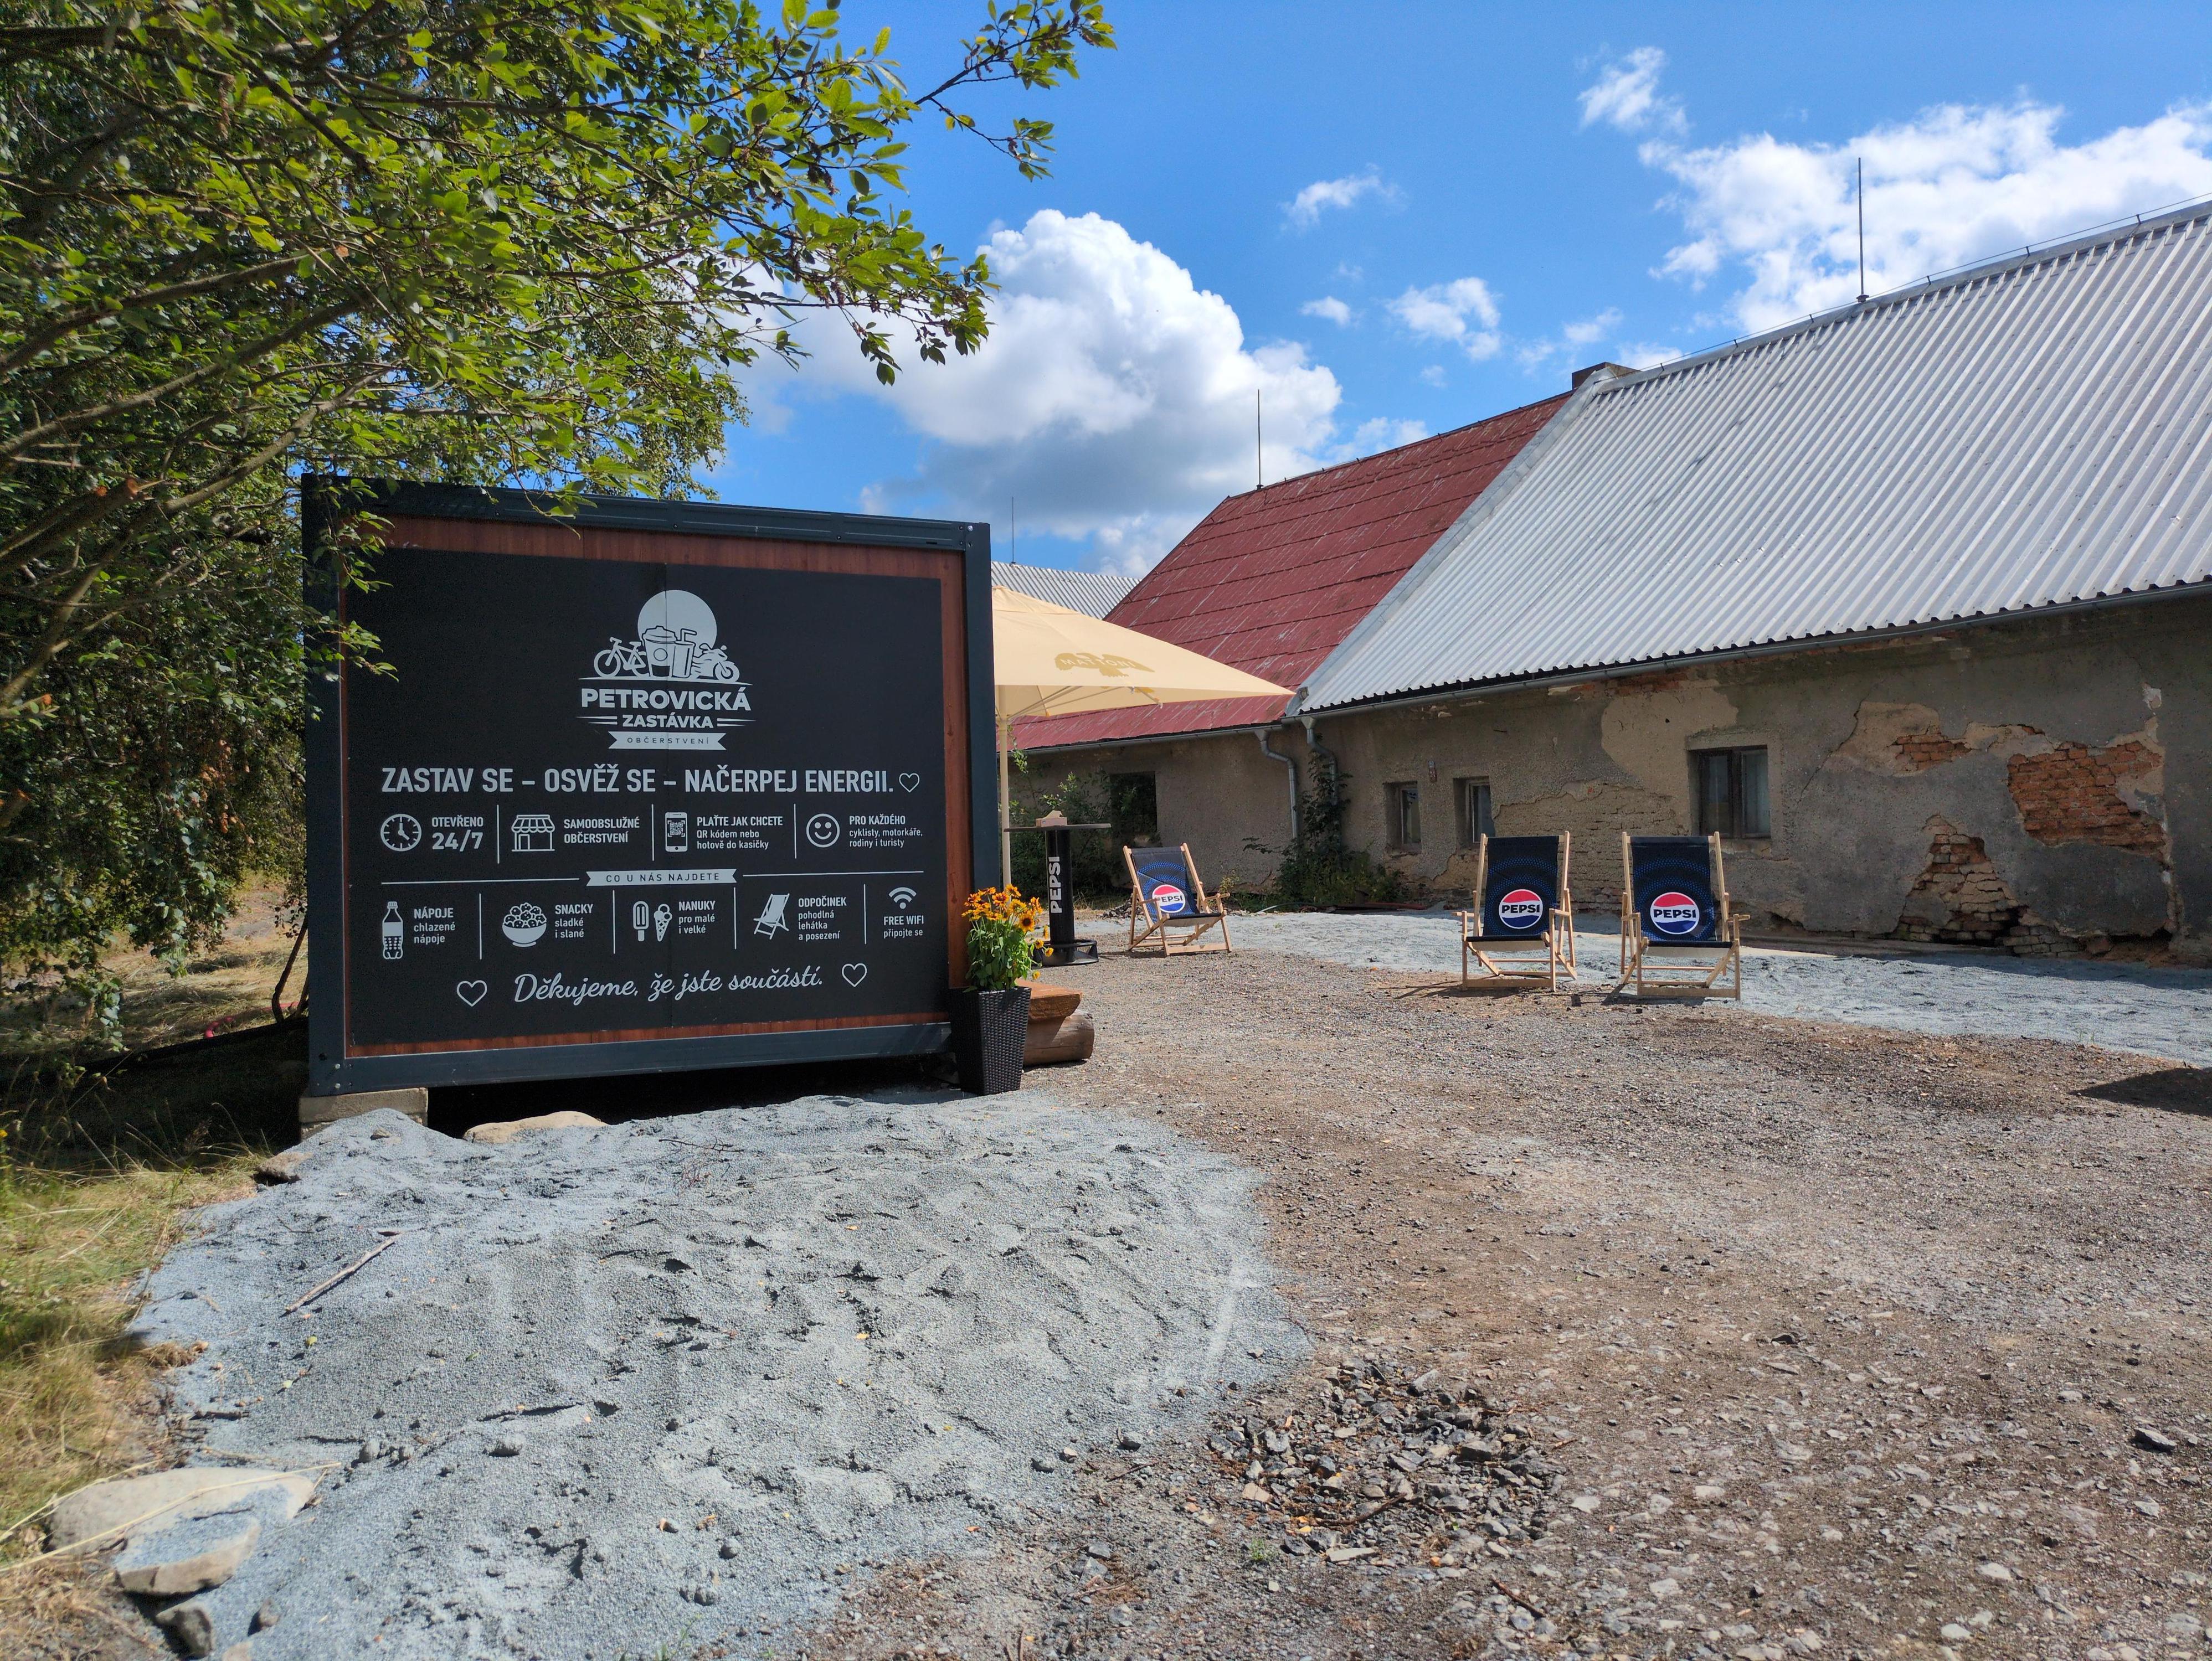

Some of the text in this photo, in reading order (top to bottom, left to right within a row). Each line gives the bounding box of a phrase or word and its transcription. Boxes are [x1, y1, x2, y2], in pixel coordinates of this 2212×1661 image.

[1060, 658, 1136, 667] MATTONI
[581, 687, 751, 711] PETROVICKÁ
[622, 712, 714, 729] ZASTÁVKA
[627, 736, 709, 745] OBČERSTVENÍ
[382, 768, 474, 792] ZASTAV
[482, 768, 513, 792] SE
[545, 764, 620, 792] OSVĚŽ
[627, 769, 656, 792] SE
[685, 765, 797, 792] NAČERPEJ
[805, 770, 893, 792] ENERGII.
[432, 814, 483, 827] OTEVŘENO
[564, 815, 640, 828] SAMOOBSLUŽNÉ
[697, 814, 783, 826] PLAŤTE JAK CHCETE
[850, 814, 906, 825] PRO KAŽDÉHO
[564, 831, 629, 843] OBČERSTVENÍ
[697, 830, 708, 838] QR
[710, 829, 737, 838] kódem
[849, 827, 923, 838] cyklisty, motorkáře,
[432, 829, 483, 852] 24/7
[697, 839, 769, 850] hotově do kasičky
[850, 838, 904, 849] rodiny i turisty
[640, 873, 662, 881] NÁS
[1048, 857, 1062, 913] PEPSI
[678, 900, 716, 911] NANUKY
[798, 895, 847, 907] ODPOČINEK
[414, 906, 454, 919] NÁPOJE
[555, 904, 593, 915] SNACKY
[1501, 904, 1540, 914] PEPSI
[1653, 908, 1696, 919] PEPSI
[678, 914, 715, 926] pro malé
[798, 910, 834, 922] pohodlná
[884, 915, 924, 926] FREE WIFI
[414, 922, 455, 932] chlazené
[555, 917, 584, 927] sladké
[798, 921, 827, 930] lehátka
[555, 928, 584, 938] i slané
[678, 925, 706, 934] i velké
[884, 928, 912, 939] připojte
[414, 934, 445, 945] nápoje
[806, 931, 840, 942] posezení
[515, 966, 822, 1005] Děkujeme, že jste součástí.
